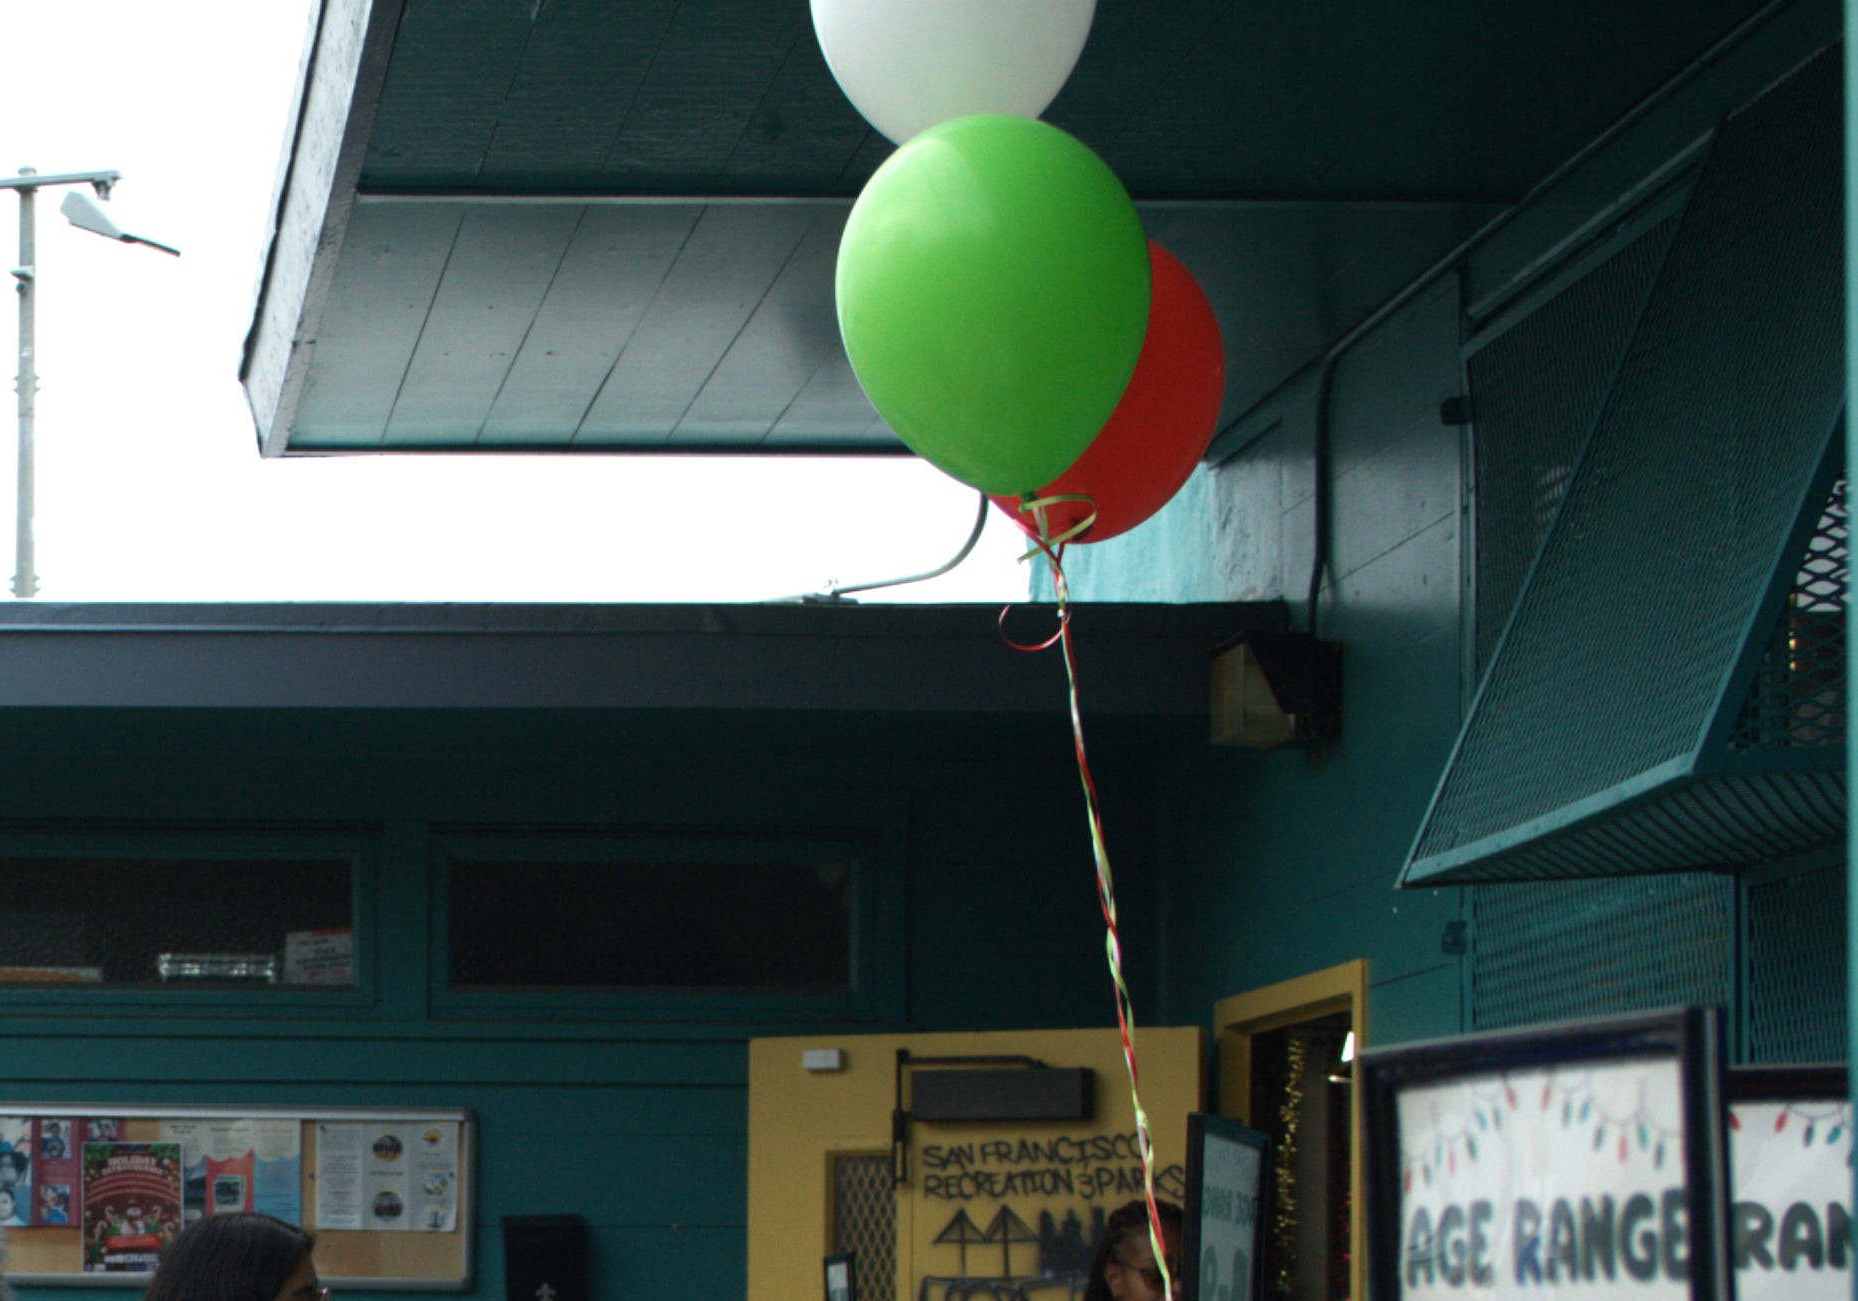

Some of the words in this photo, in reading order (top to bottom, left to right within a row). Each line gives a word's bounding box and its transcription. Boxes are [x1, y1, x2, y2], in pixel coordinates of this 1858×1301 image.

[923, 1143, 974, 1170] SAN
[980, 1134, 1144, 1166] FRANCISCO
[924, 1170, 1074, 1199] RECREATION
[1406, 1204, 1495, 1289] AGE
[1512, 1186, 1689, 1289] RANGE
